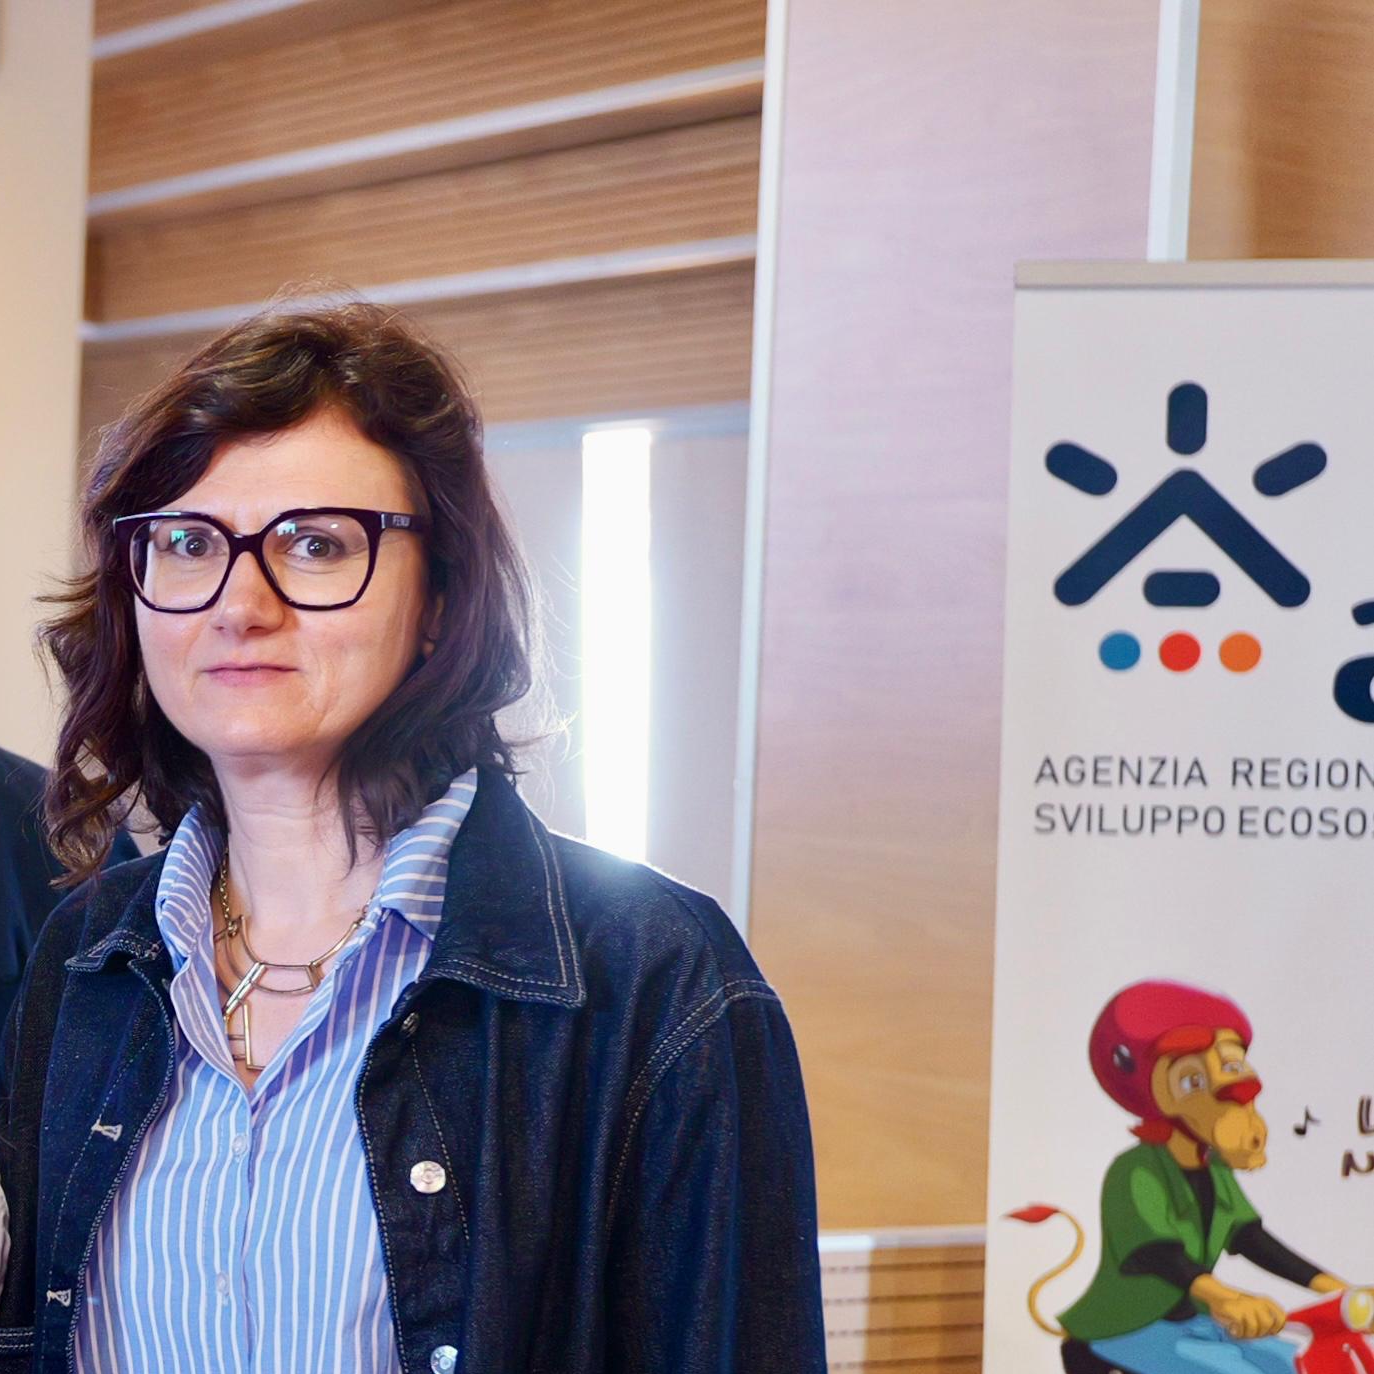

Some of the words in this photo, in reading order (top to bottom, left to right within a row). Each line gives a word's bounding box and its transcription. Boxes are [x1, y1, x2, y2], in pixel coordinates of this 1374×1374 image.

[1034, 754, 1207, 787] AGENZIA
[1231, 756, 1374, 790] REGION
[1034, 802, 1225, 836] SVILUPPO
[1238, 804, 1374, 838] ECOSO
